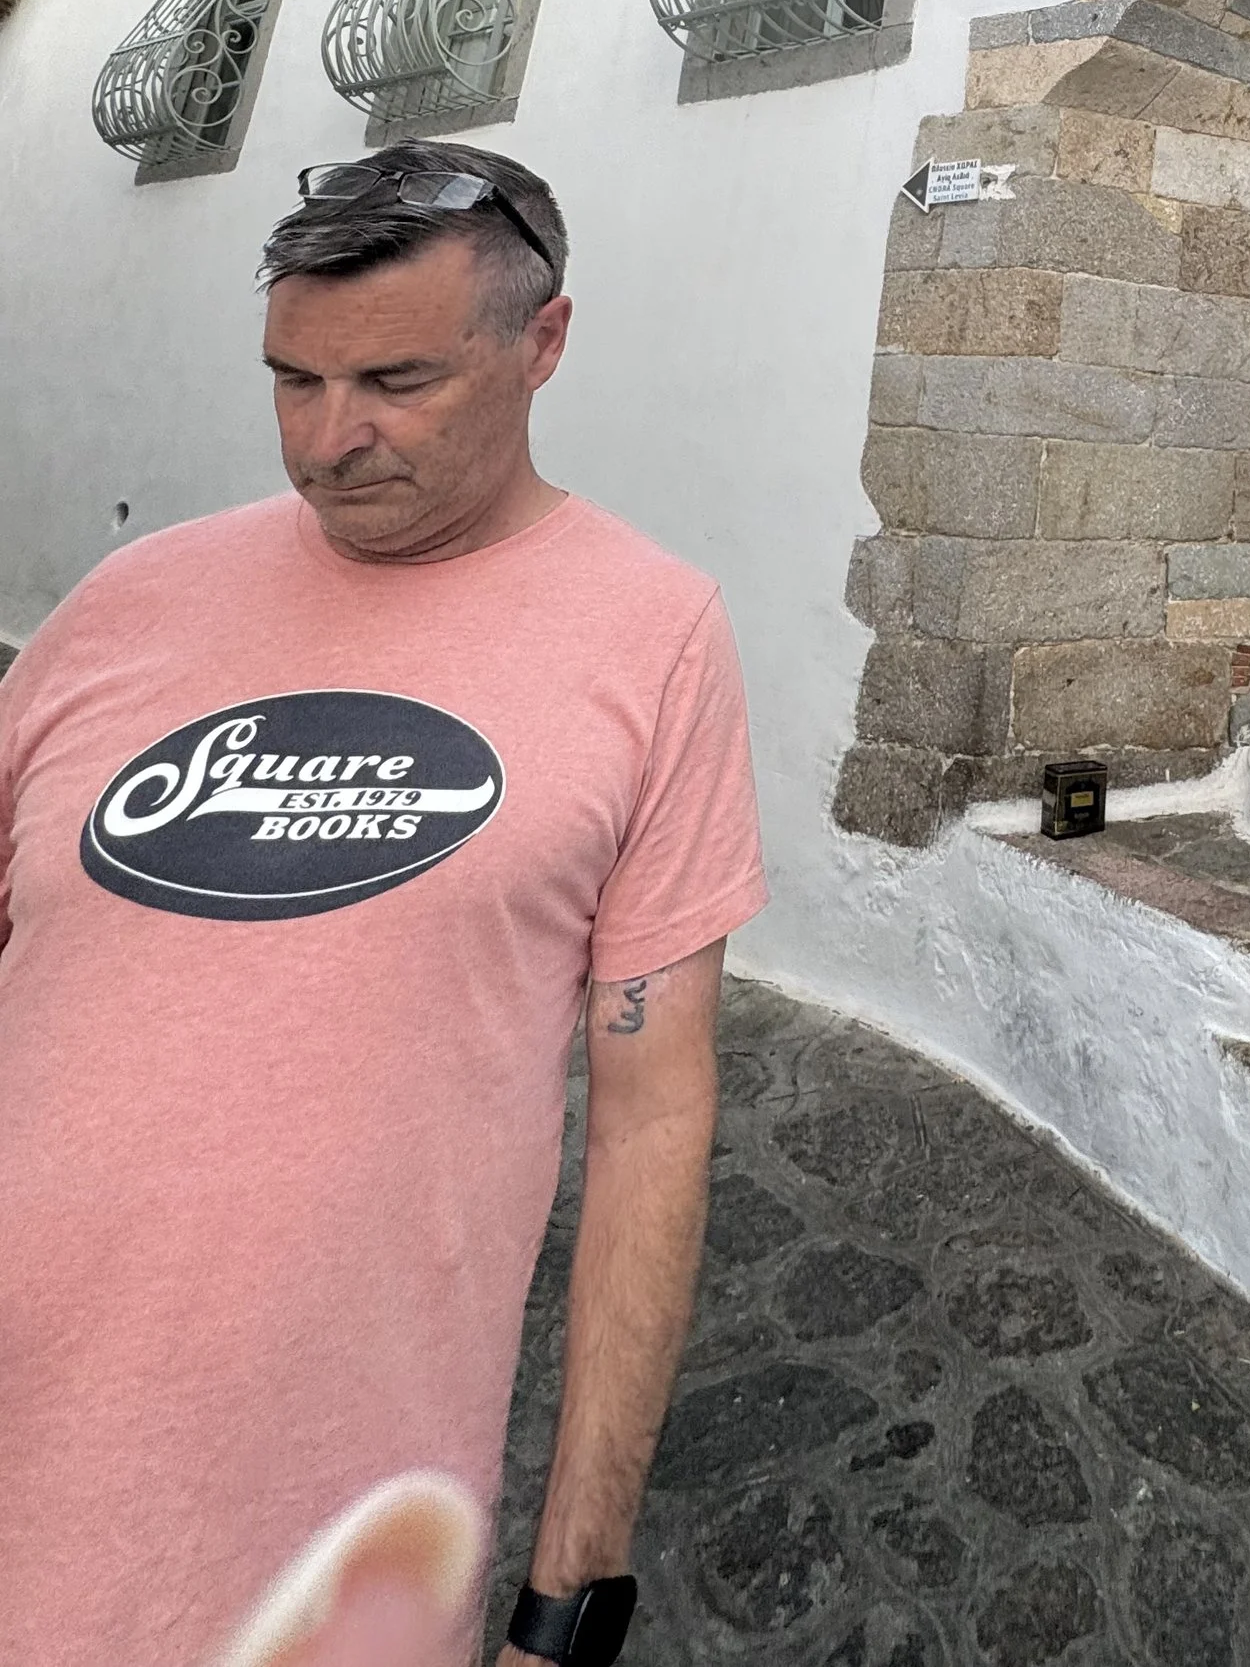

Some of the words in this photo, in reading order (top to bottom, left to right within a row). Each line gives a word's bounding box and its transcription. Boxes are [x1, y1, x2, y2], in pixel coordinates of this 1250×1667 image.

[957, 161, 977, 169] ΧΩΡΑΣ
[928, 185, 951, 193] CHORA
[104, 715, 415, 836] Square
[279, 791, 341, 810] EST.
[352, 789, 422, 808] 1979
[251, 814, 423, 841] BOOKS
